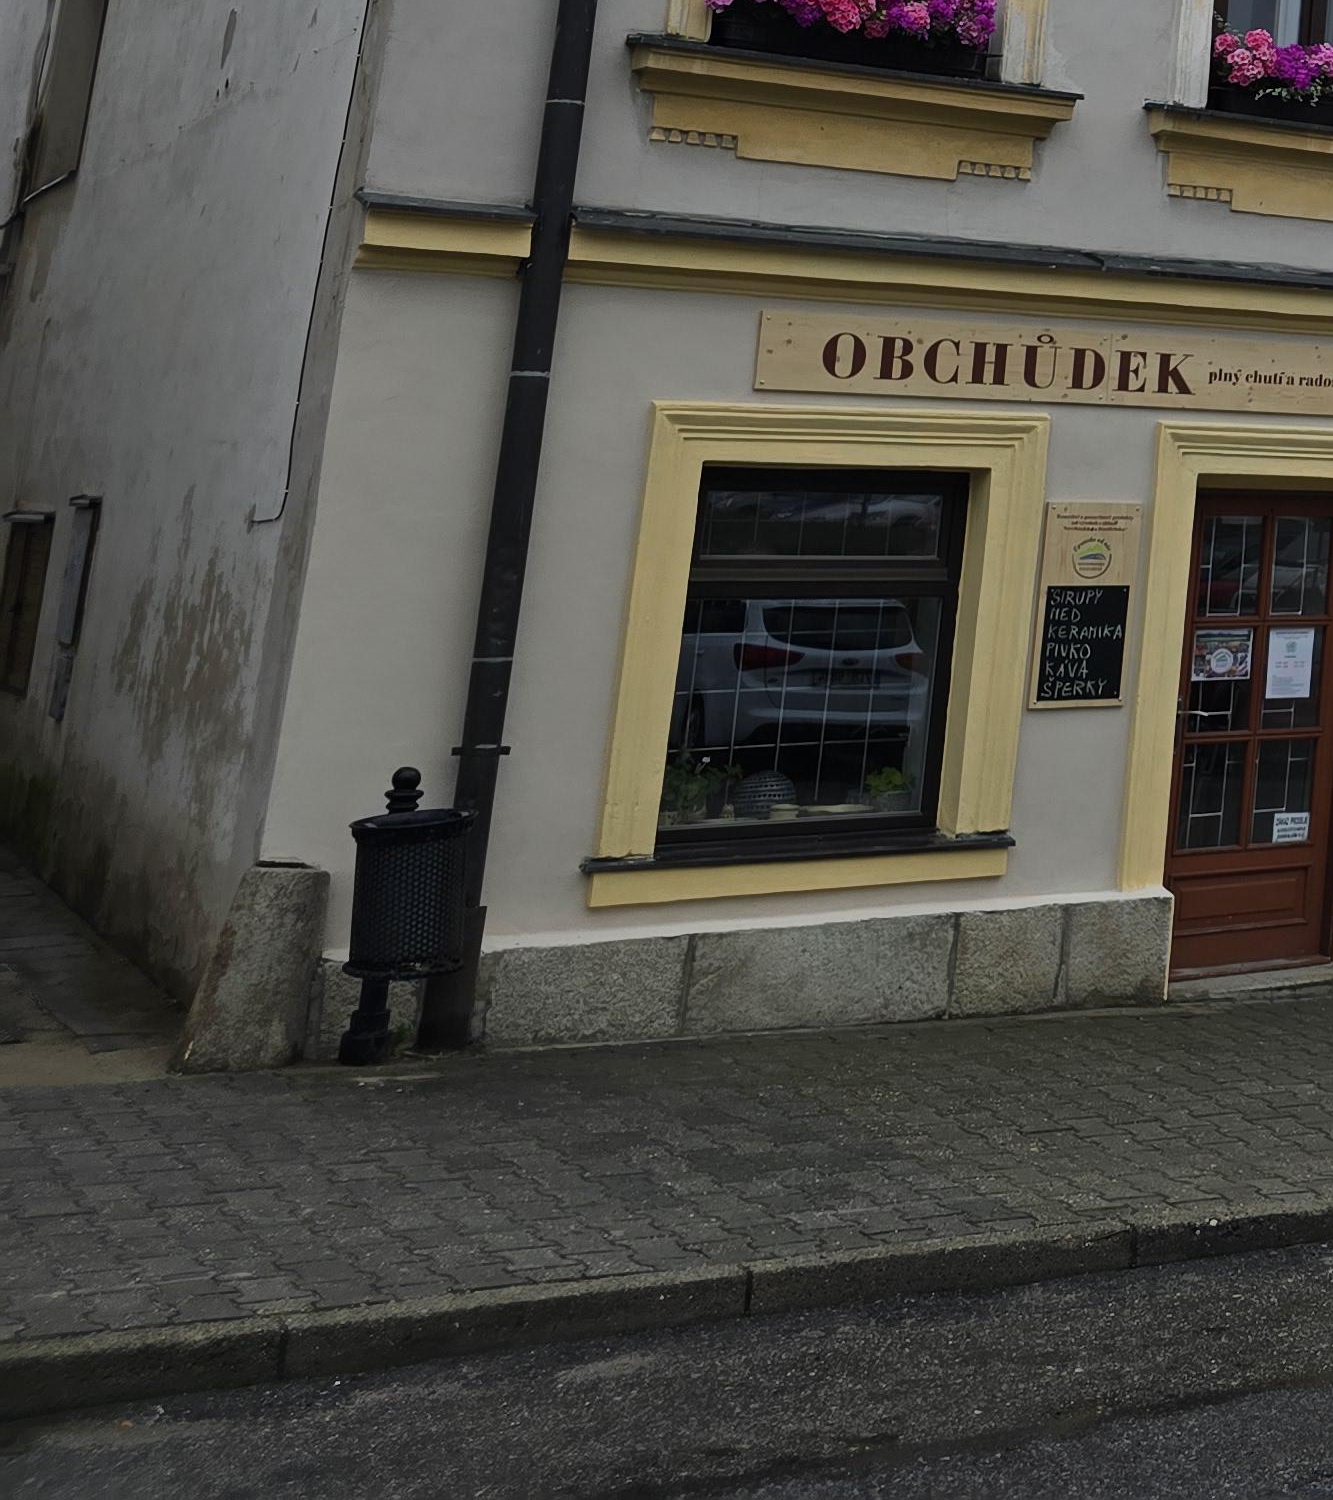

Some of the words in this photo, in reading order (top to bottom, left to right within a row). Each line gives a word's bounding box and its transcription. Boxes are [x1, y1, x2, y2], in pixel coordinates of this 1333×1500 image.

[821, 331, 1196, 396] OBCHŮDEK
[1208, 368, 1242, 386] plný
[1245, 370, 1286, 385] chutí
[1286, 375, 1294, 386] a
[1051, 588, 1104, 606] SIRUPY
[1047, 624, 1123, 640] KERAMIKA
[1046, 642, 1091, 660] PIVKO
[1045, 660, 1089, 679] KÁVA
[1040, 676, 1108, 699] ŠPERKY
